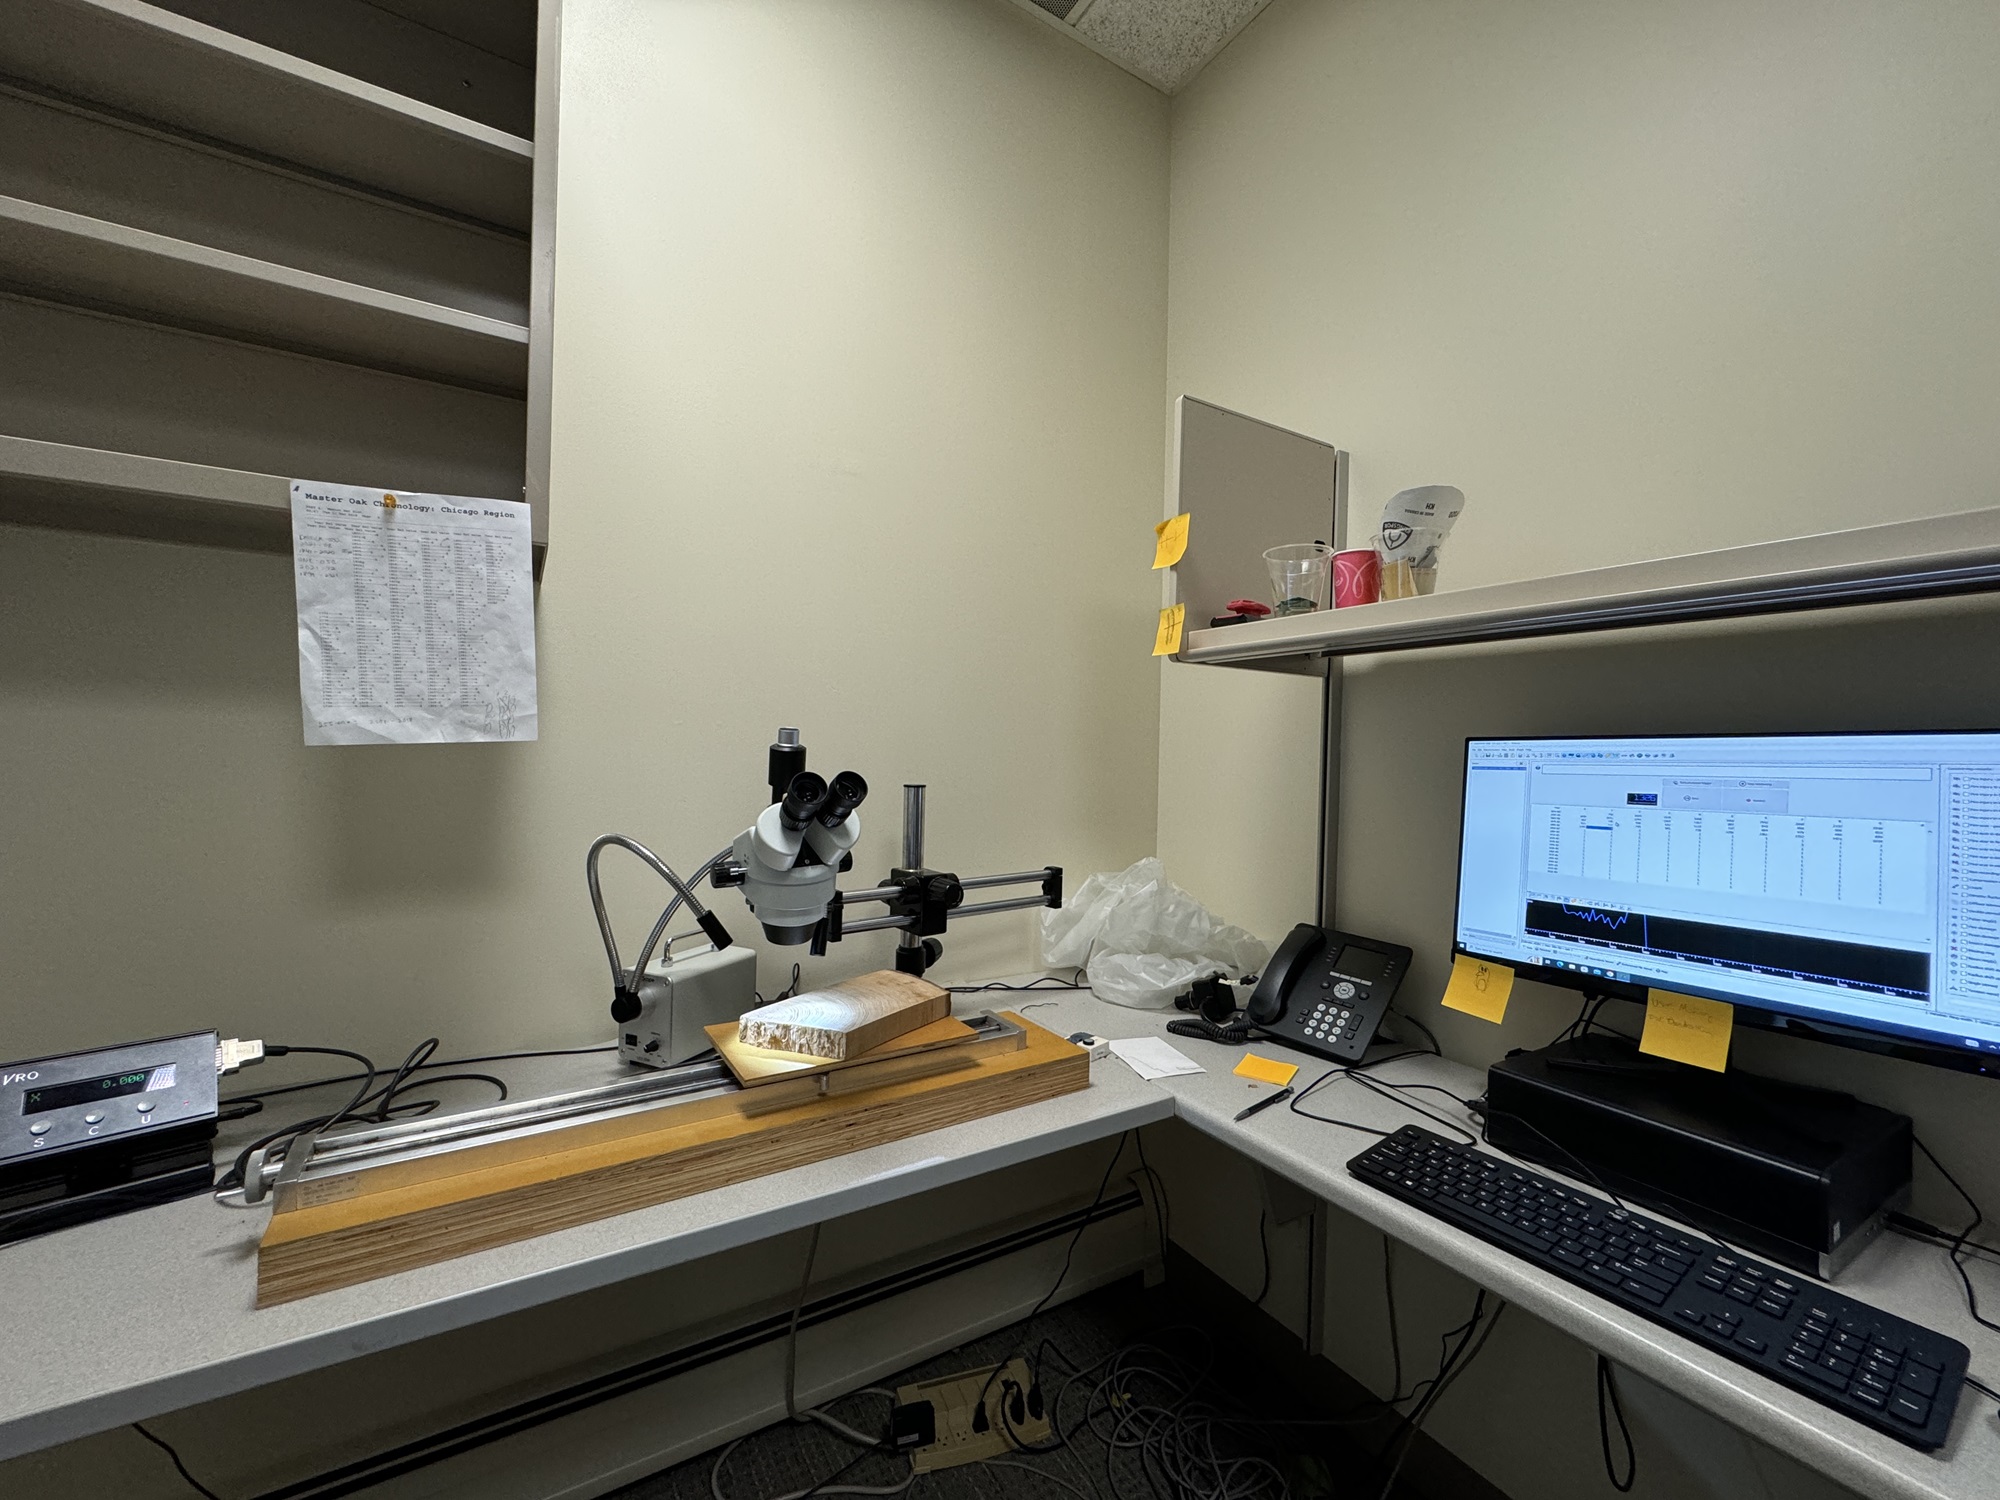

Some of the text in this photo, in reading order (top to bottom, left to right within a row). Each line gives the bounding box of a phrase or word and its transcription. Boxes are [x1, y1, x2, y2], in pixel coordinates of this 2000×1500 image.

[305, 493, 343, 503] Master
[349, 498, 368, 506] Oak
[440, 506, 479, 516] Chicago
[483, 509, 515, 519] Region
[2, 1070, 40, 1086] VRO
[102, 1073, 145, 1089] 0.000
[33, 1115, 152, 1148] S C U
